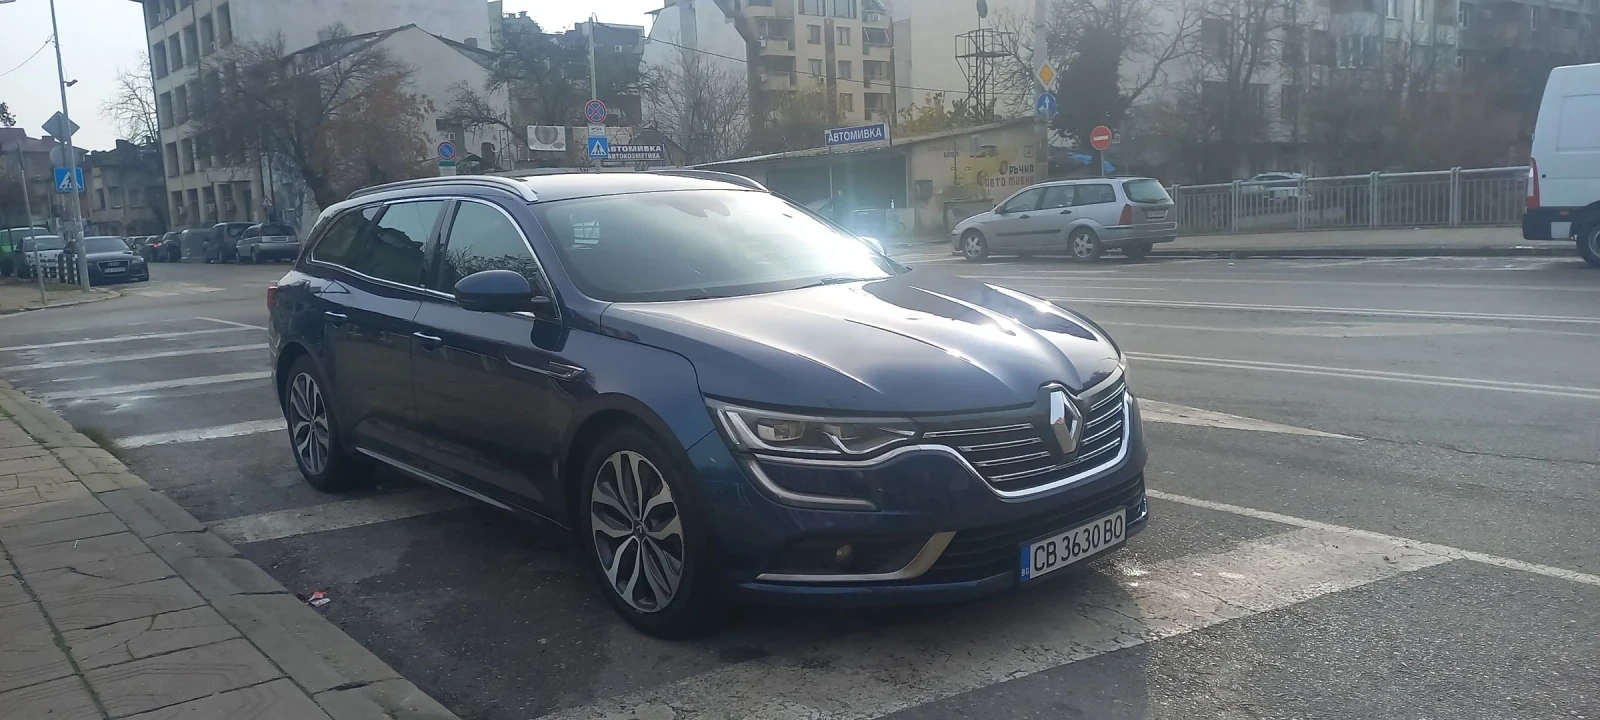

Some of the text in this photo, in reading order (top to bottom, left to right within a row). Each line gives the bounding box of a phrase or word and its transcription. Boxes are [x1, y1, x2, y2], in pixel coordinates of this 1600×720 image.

[828, 127, 882, 143] АВТОМИВКА
[1034, 514, 1123, 572] CB 3630 BO
[1021, 567, 1030, 577] BG
